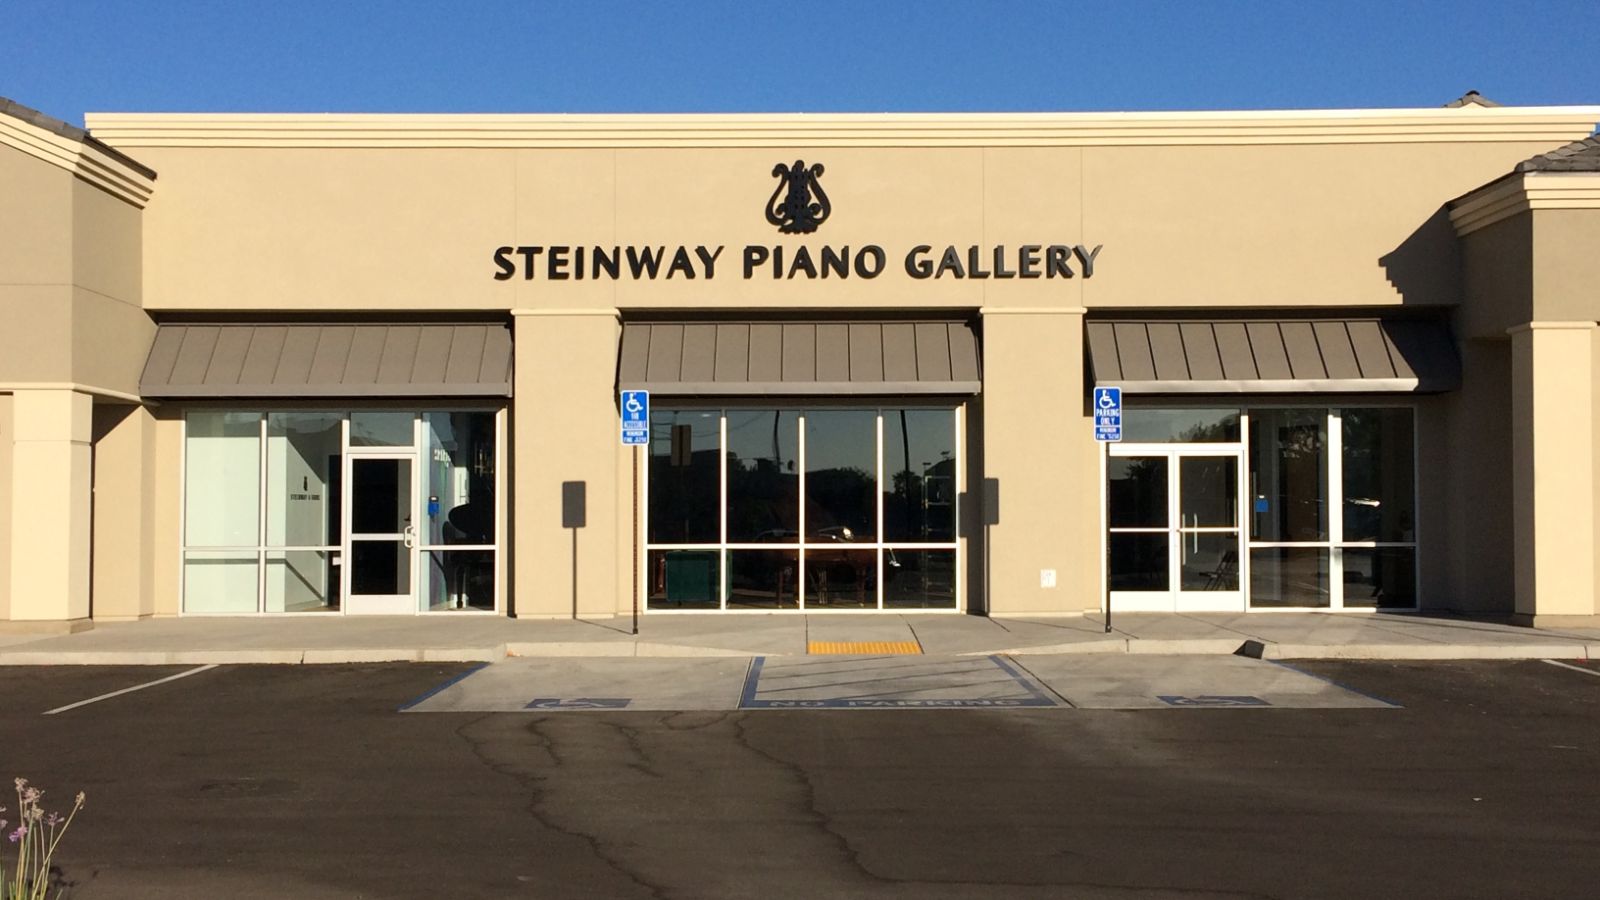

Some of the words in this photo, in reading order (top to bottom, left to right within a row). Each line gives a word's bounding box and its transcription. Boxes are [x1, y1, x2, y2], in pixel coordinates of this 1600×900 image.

[493, 246, 724, 281] STEINWAY
[743, 246, 887, 280] PIANO
[904, 244, 1104, 280] GALLERY
[1097, 409, 1120, 417] PARKING
[1100, 417, 1115, 425] ONLY
[848, 699, 1021, 707] PARKING
